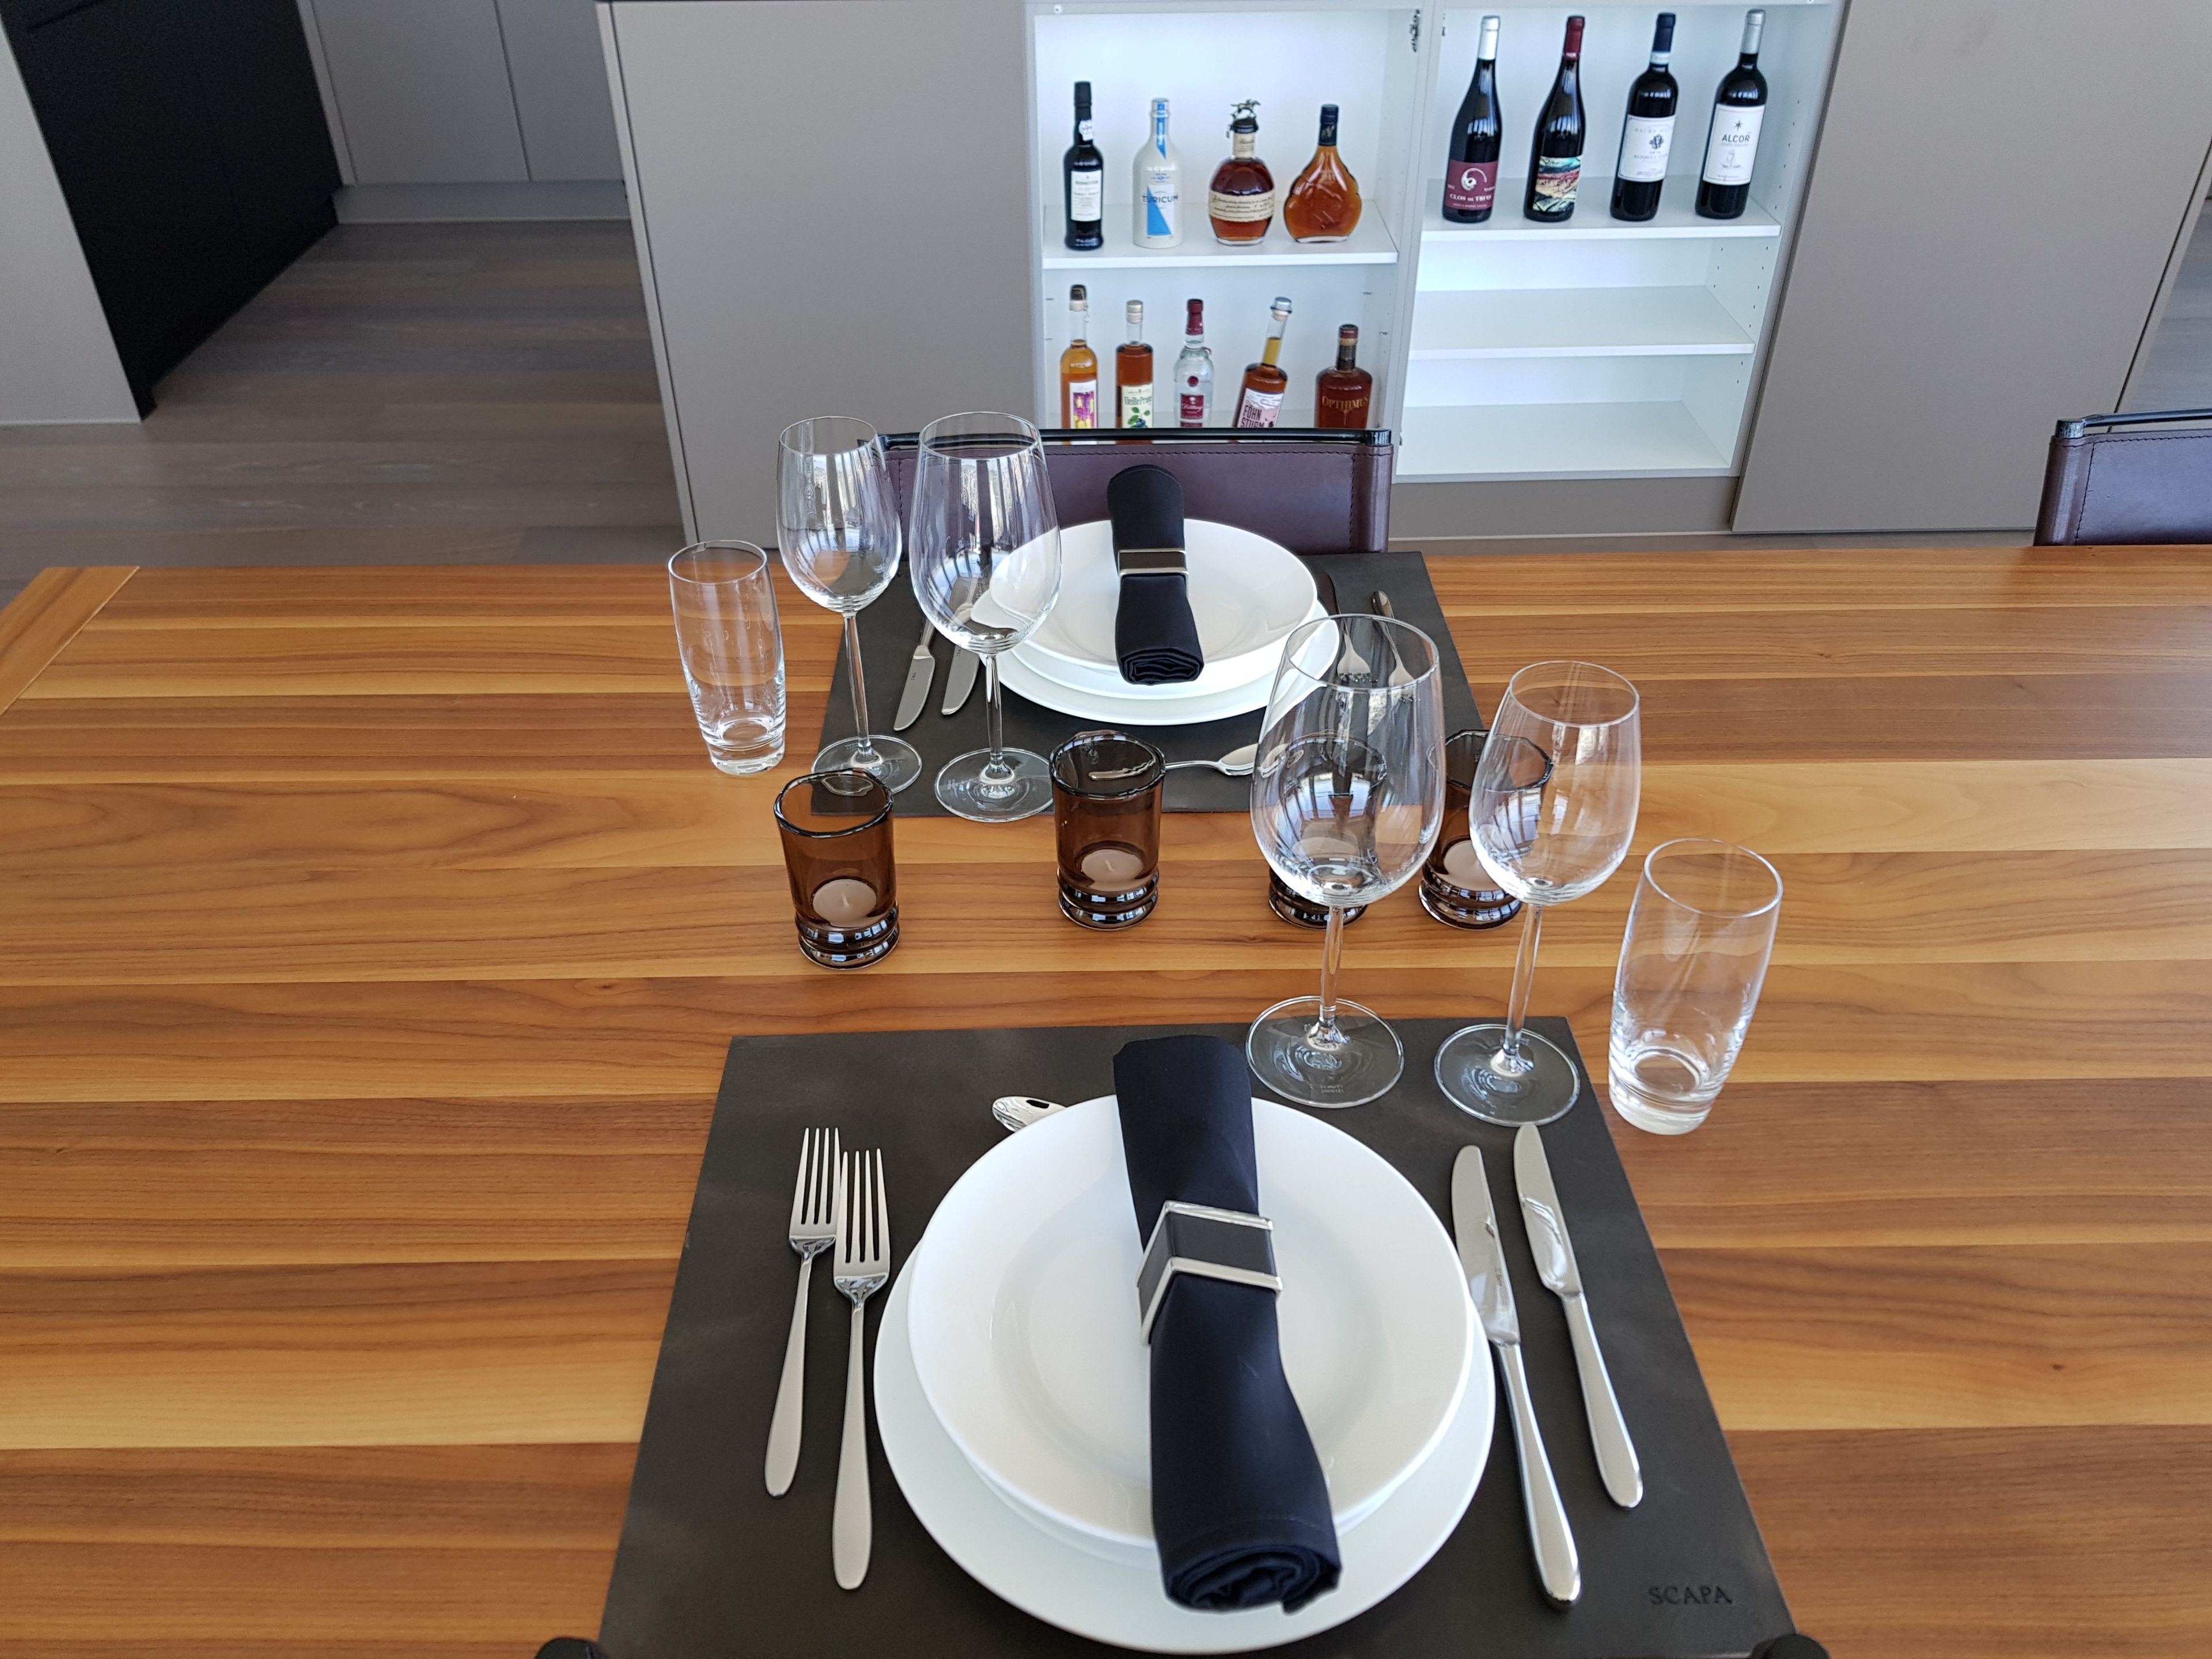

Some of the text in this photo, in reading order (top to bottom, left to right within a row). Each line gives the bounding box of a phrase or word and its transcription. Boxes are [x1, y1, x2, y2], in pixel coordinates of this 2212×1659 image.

[1722, 133, 1750, 143] ALCOR
[1142, 194, 1179, 203] TURICUM
[1243, 404, 1263, 421] FÖHN
[1648, 1585, 1733, 1605] SCAPA
